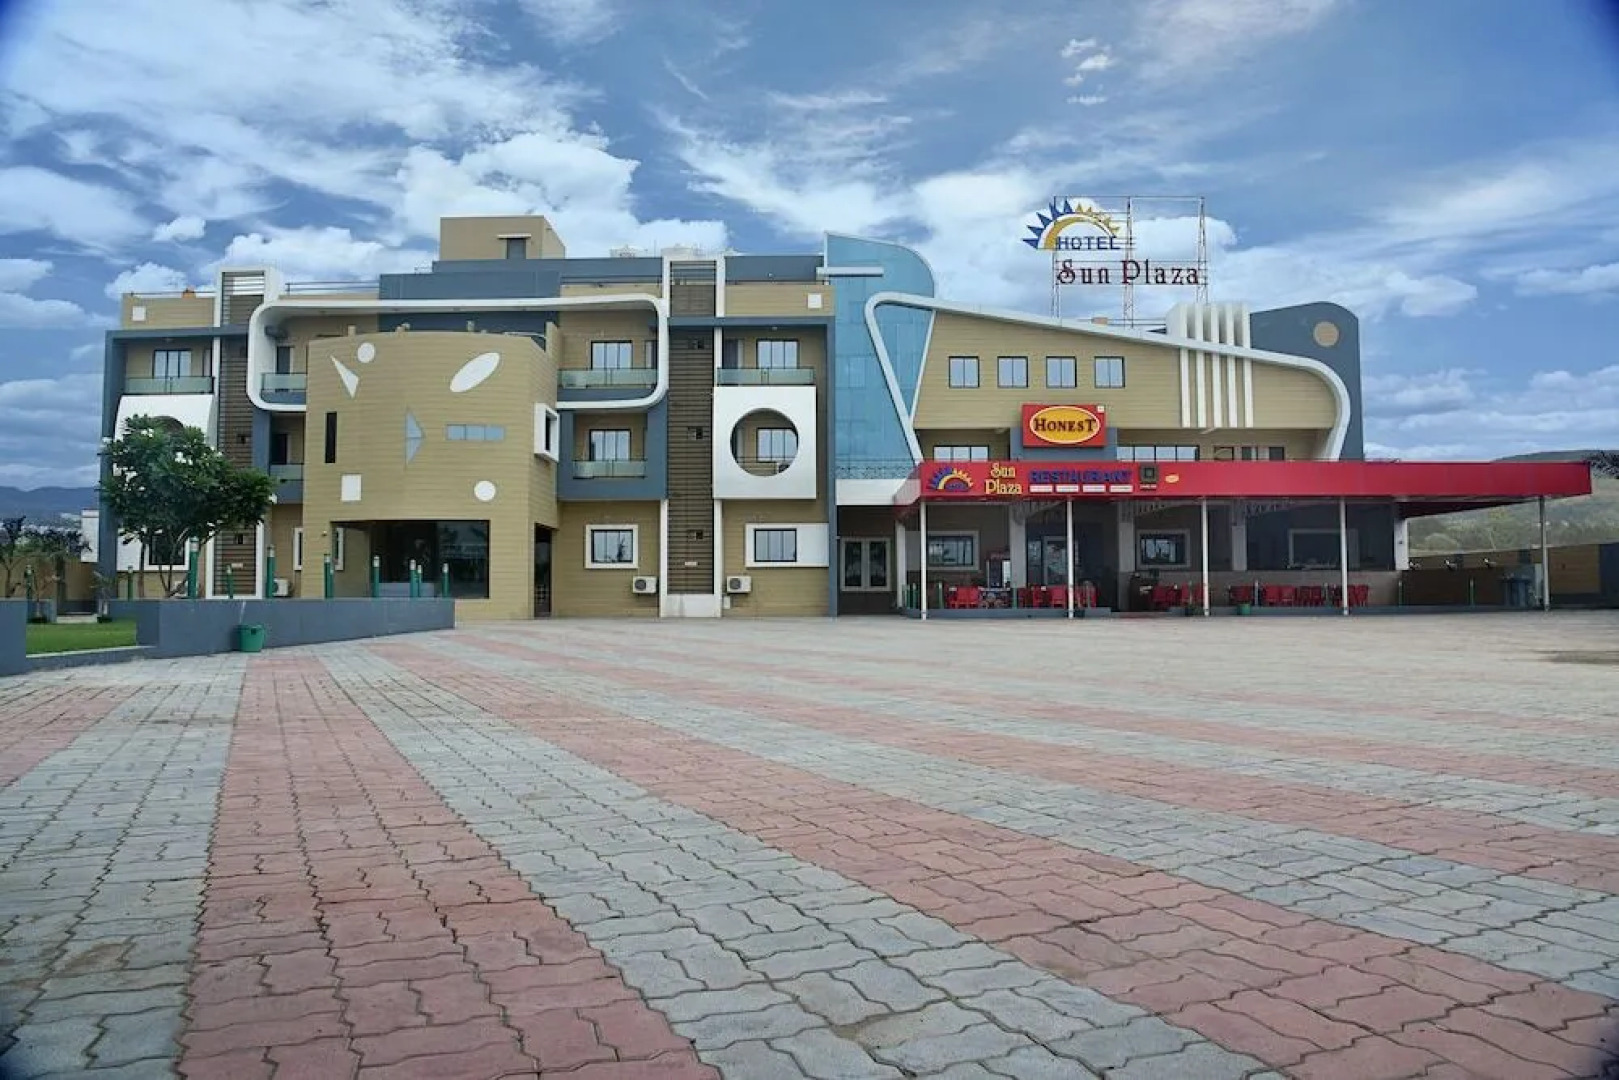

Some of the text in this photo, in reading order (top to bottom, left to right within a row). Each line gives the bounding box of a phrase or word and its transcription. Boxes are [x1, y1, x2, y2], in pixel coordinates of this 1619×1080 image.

[1057, 236, 1121, 250] HOTEL
[1056, 258, 1199, 285] Sun Plaza
[990, 461, 1016, 478] Sun
[985, 479, 1022, 495] Plaza
